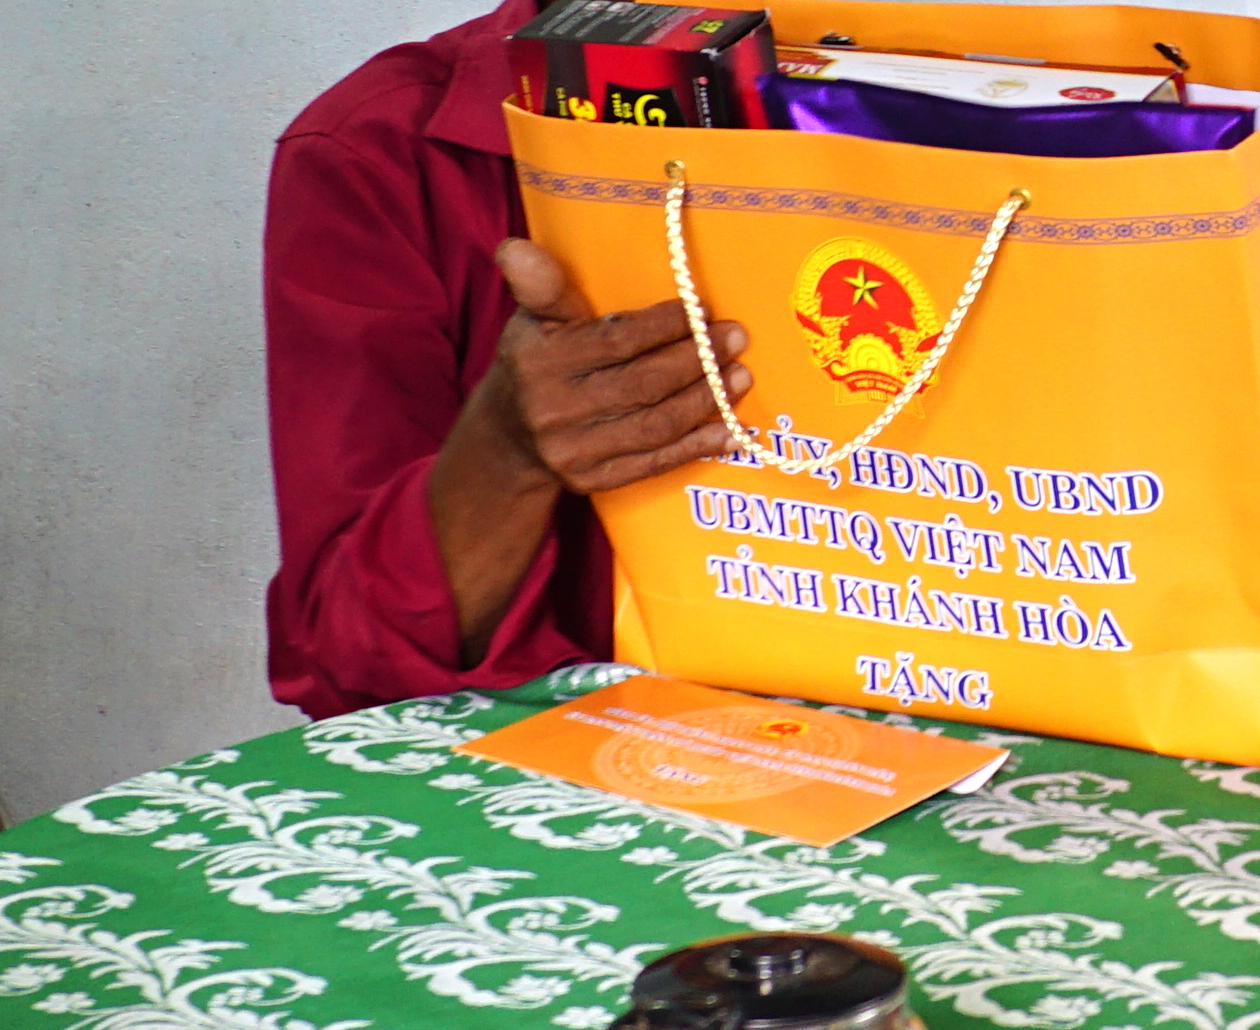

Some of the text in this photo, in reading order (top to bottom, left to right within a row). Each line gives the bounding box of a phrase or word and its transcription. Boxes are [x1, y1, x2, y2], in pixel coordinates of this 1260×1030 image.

[850, 446, 1002, 512] HĐND,
[1007, 467, 1161, 514] UBND
[687, 485, 1135, 582] UBMTTQ VIỆT NAM
[707, 544, 1132, 651] TỈNH KHÁNH HÒA
[858, 652, 992, 708] TẶNG
